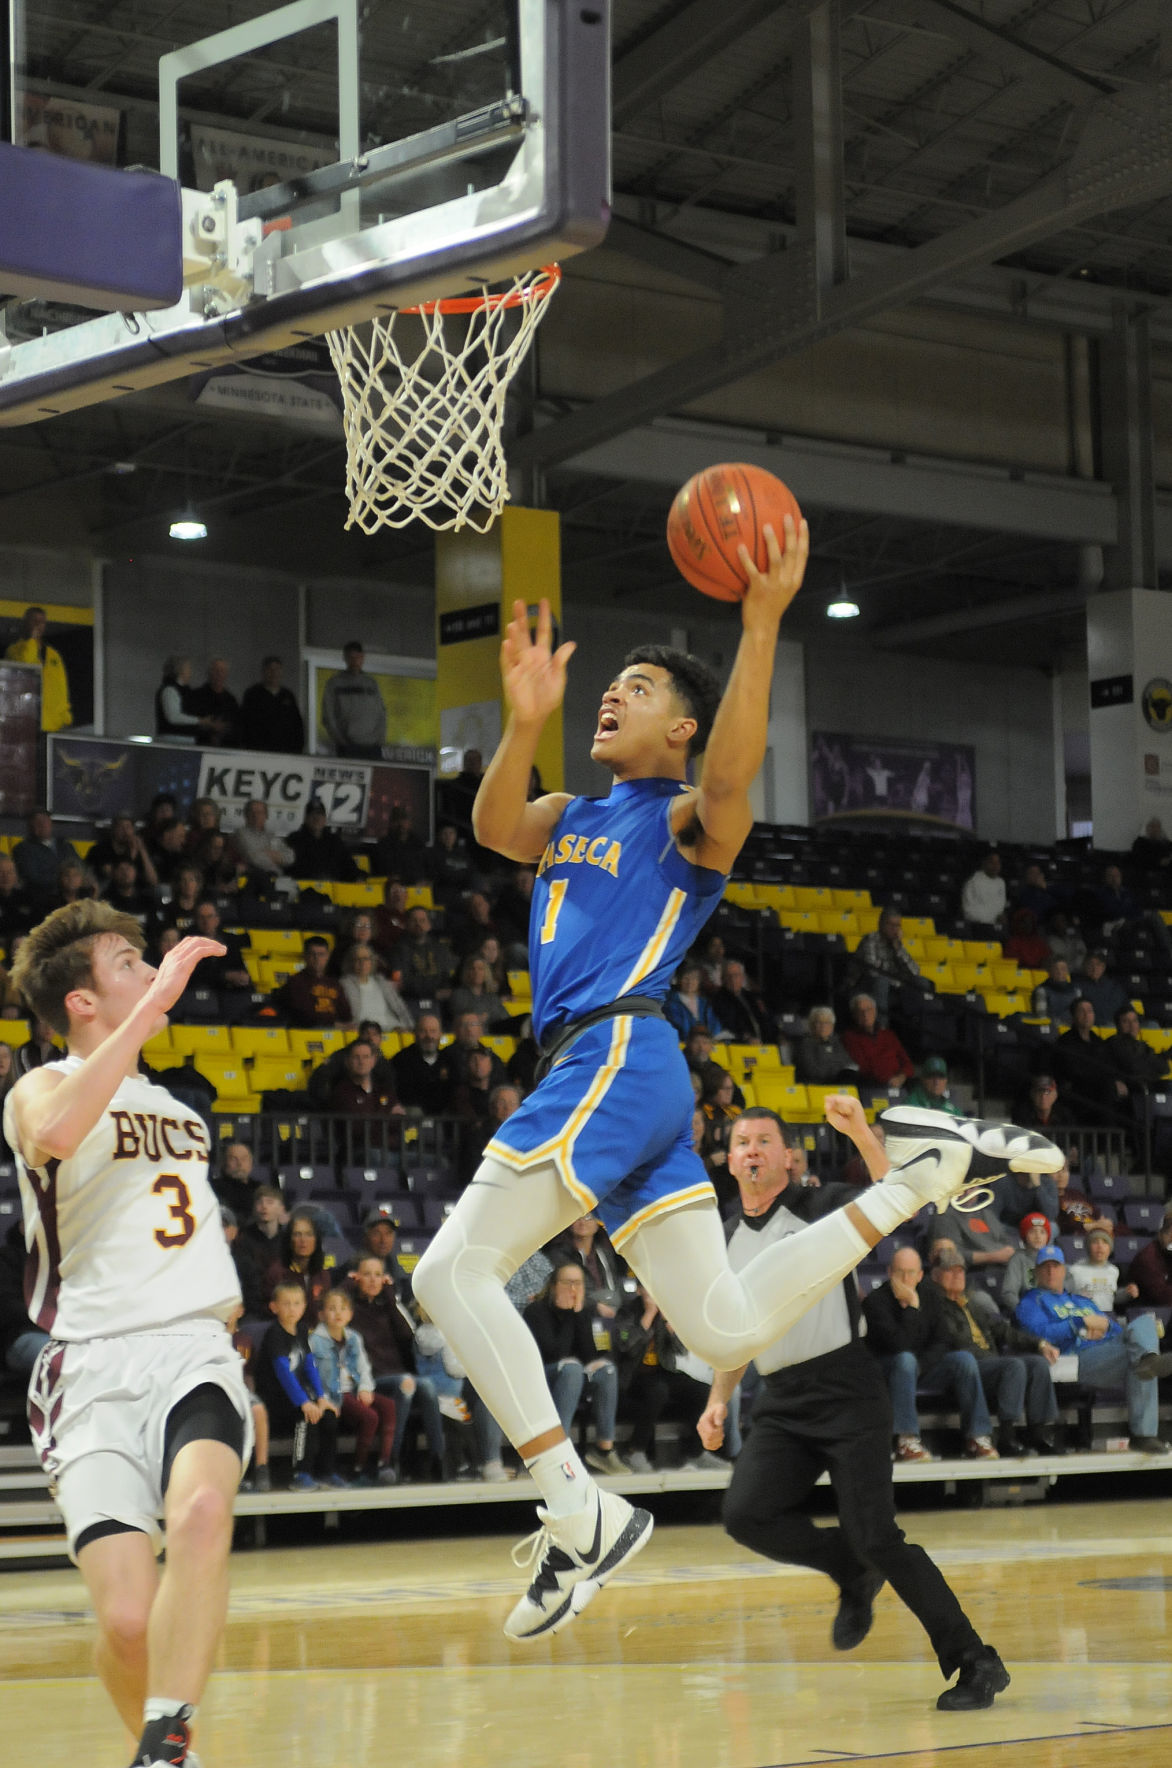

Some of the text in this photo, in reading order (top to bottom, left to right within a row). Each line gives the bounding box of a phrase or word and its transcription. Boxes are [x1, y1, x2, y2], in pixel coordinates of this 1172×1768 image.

[205, 767, 303, 801] KEYC
[315, 768, 364, 780] NEWS
[315, 783, 363, 823] 12
[536, 834, 621, 878] ASECA
[541, 878, 569, 945] 1
[109, 1110, 209, 1163] BUCS
[151, 1173, 196, 1249] 3
